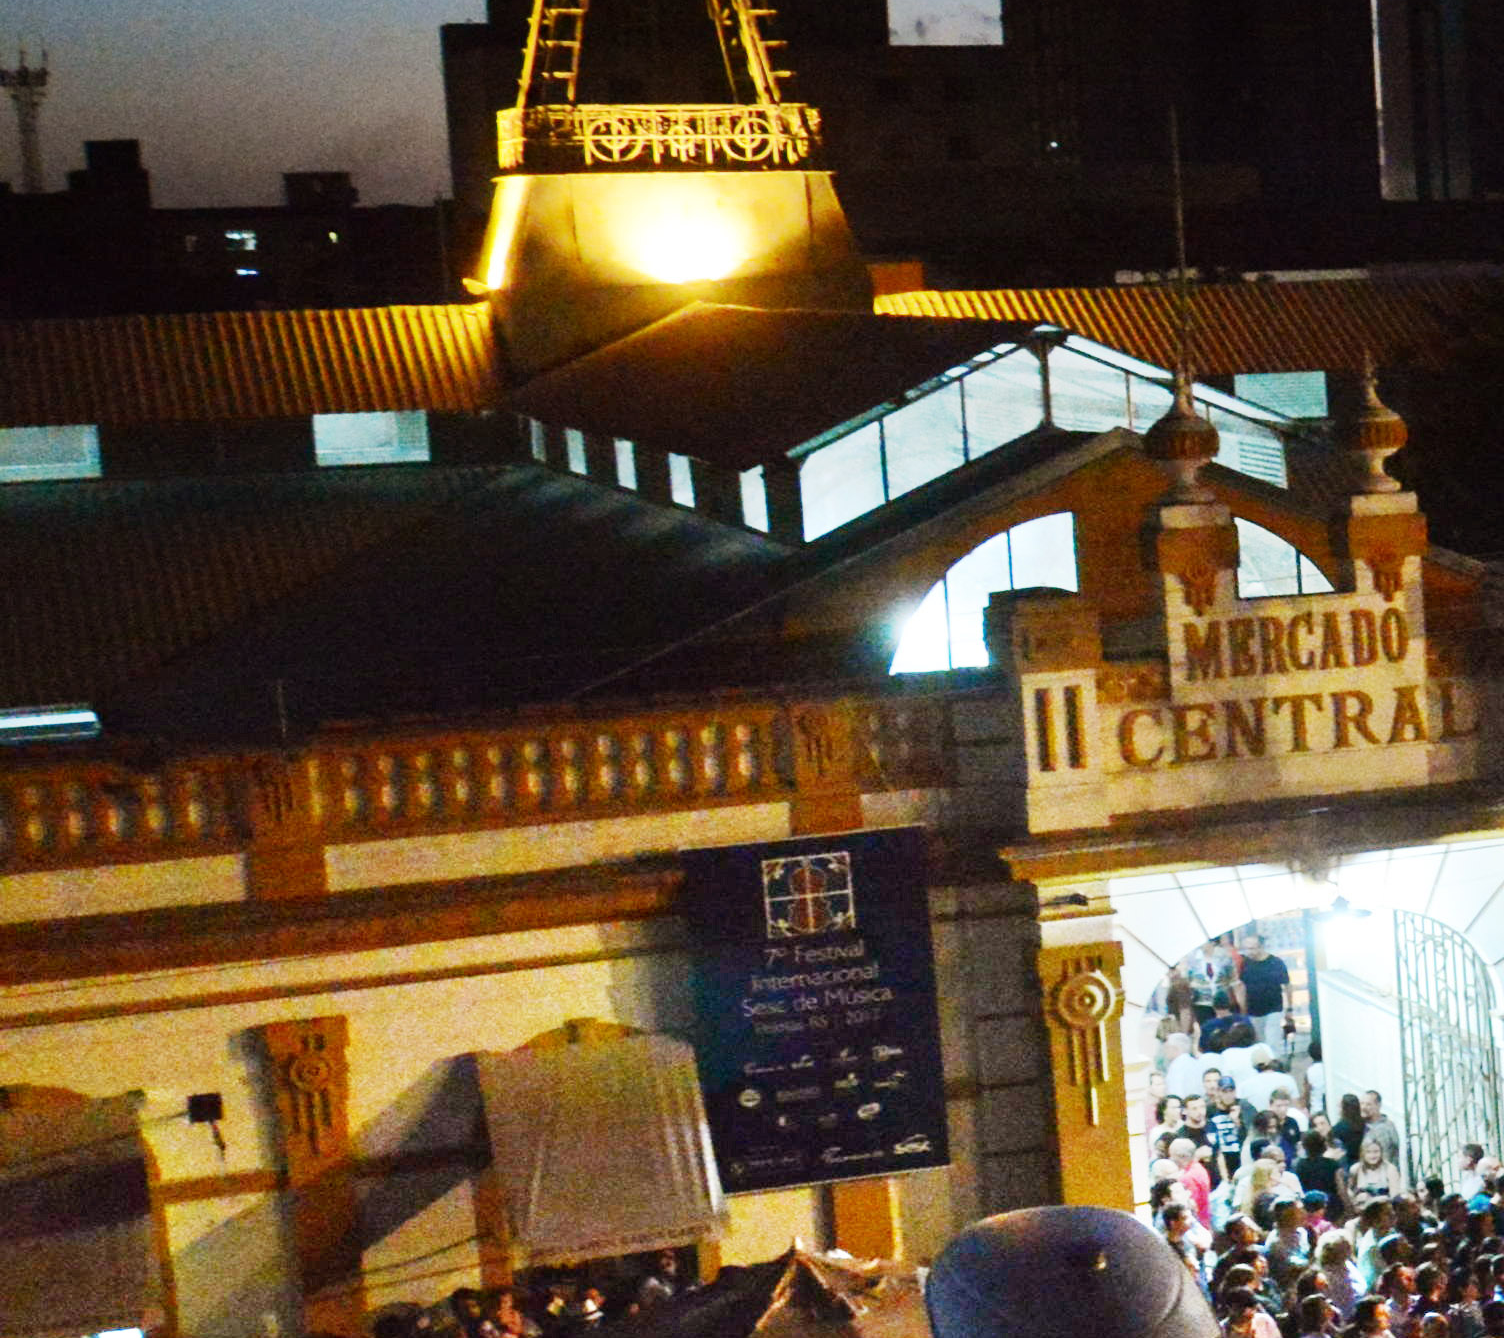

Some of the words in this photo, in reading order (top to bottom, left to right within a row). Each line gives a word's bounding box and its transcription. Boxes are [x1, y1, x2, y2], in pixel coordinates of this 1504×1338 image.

[1182, 606, 1410, 682] MERCADO
[1117, 682, 1479, 768] CENTRAL
[794, 938, 865, 964] Festival
[750, 961, 881, 992] Internacional
[741, 997, 786, 1018] Sesc
[792, 992, 819, 1012] de
[824, 985, 895, 1006] Música
